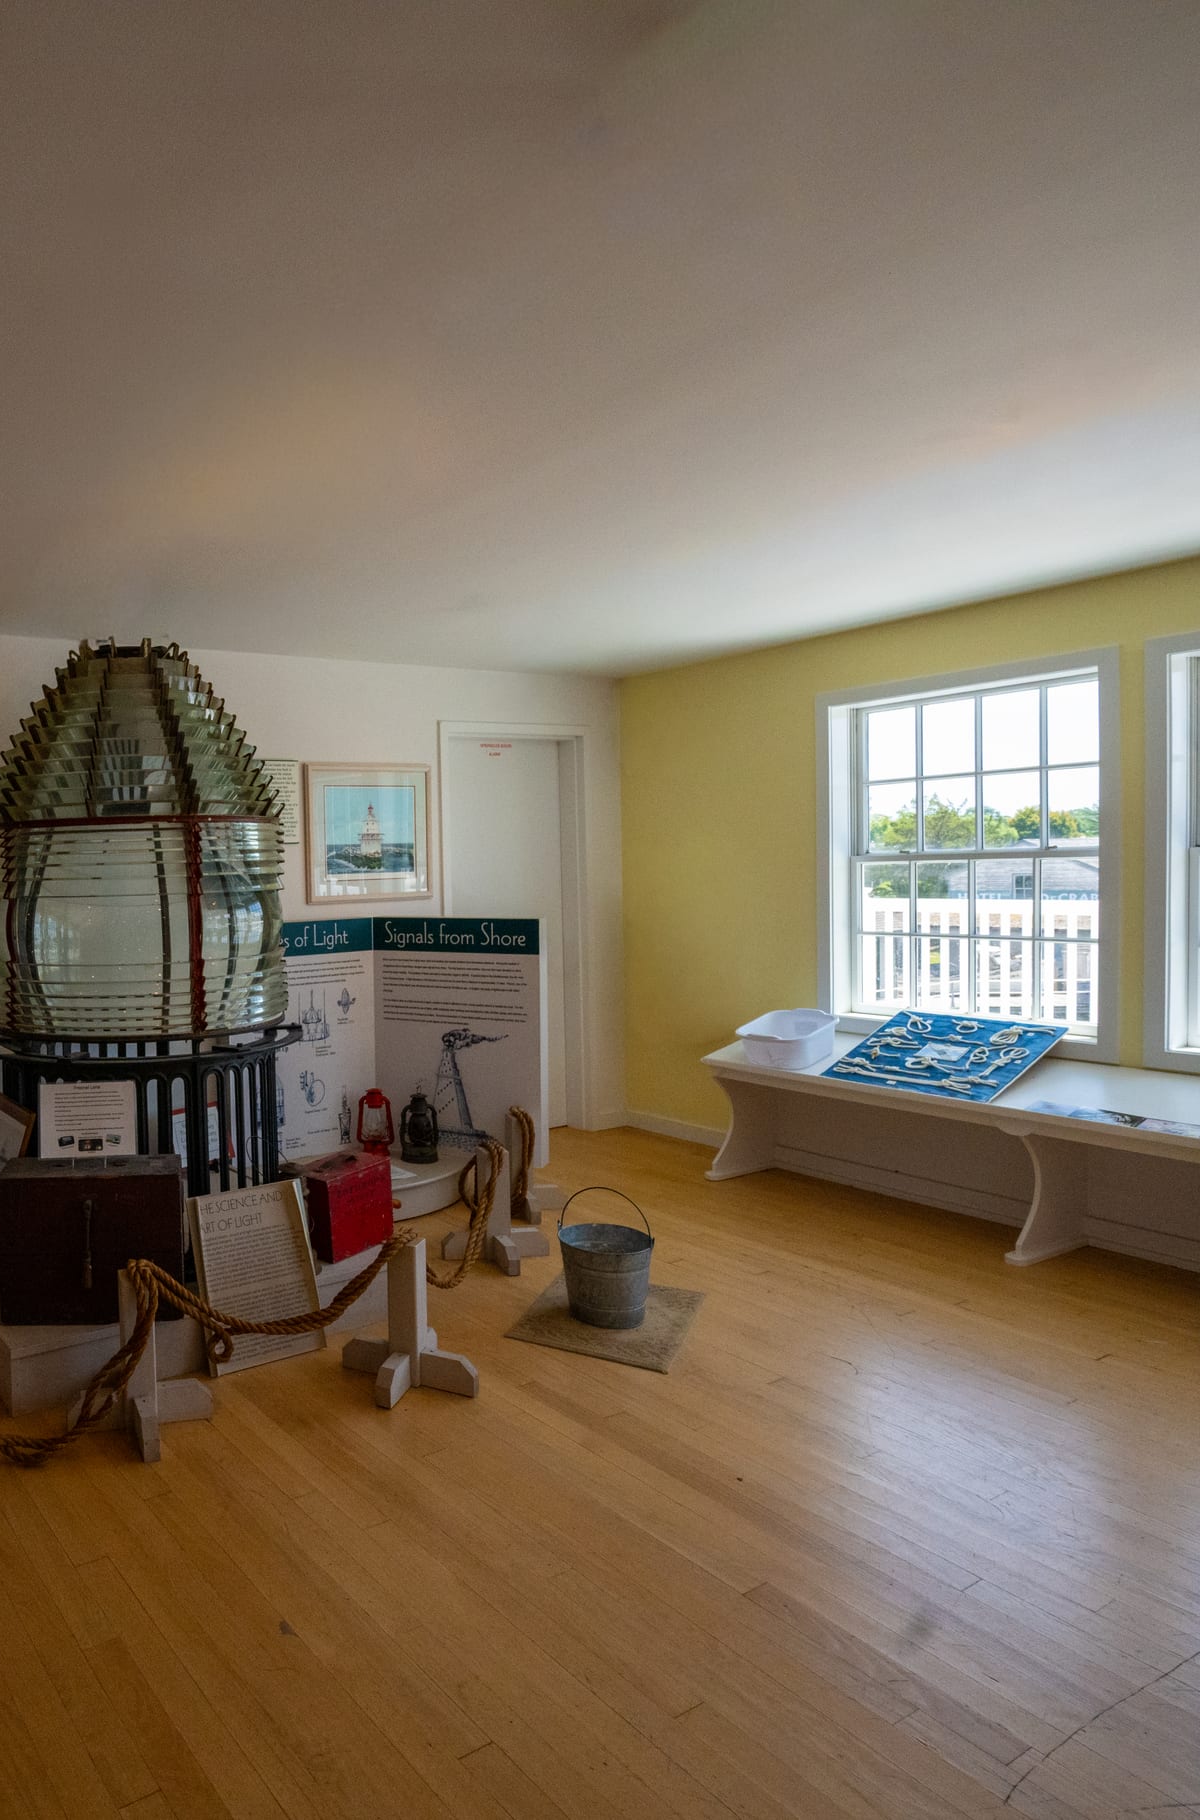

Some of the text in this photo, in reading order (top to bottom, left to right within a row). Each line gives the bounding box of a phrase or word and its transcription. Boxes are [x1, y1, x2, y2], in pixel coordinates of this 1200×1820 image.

[294, 926, 310, 947] of
[313, 922, 349, 950] Light
[384, 920, 526, 948] Signals from Shore
[200, 1191, 283, 1215] HE SCIENCE AND
[217, 1218, 232, 1231] OF
[235, 1212, 263, 1228] LIGHT
